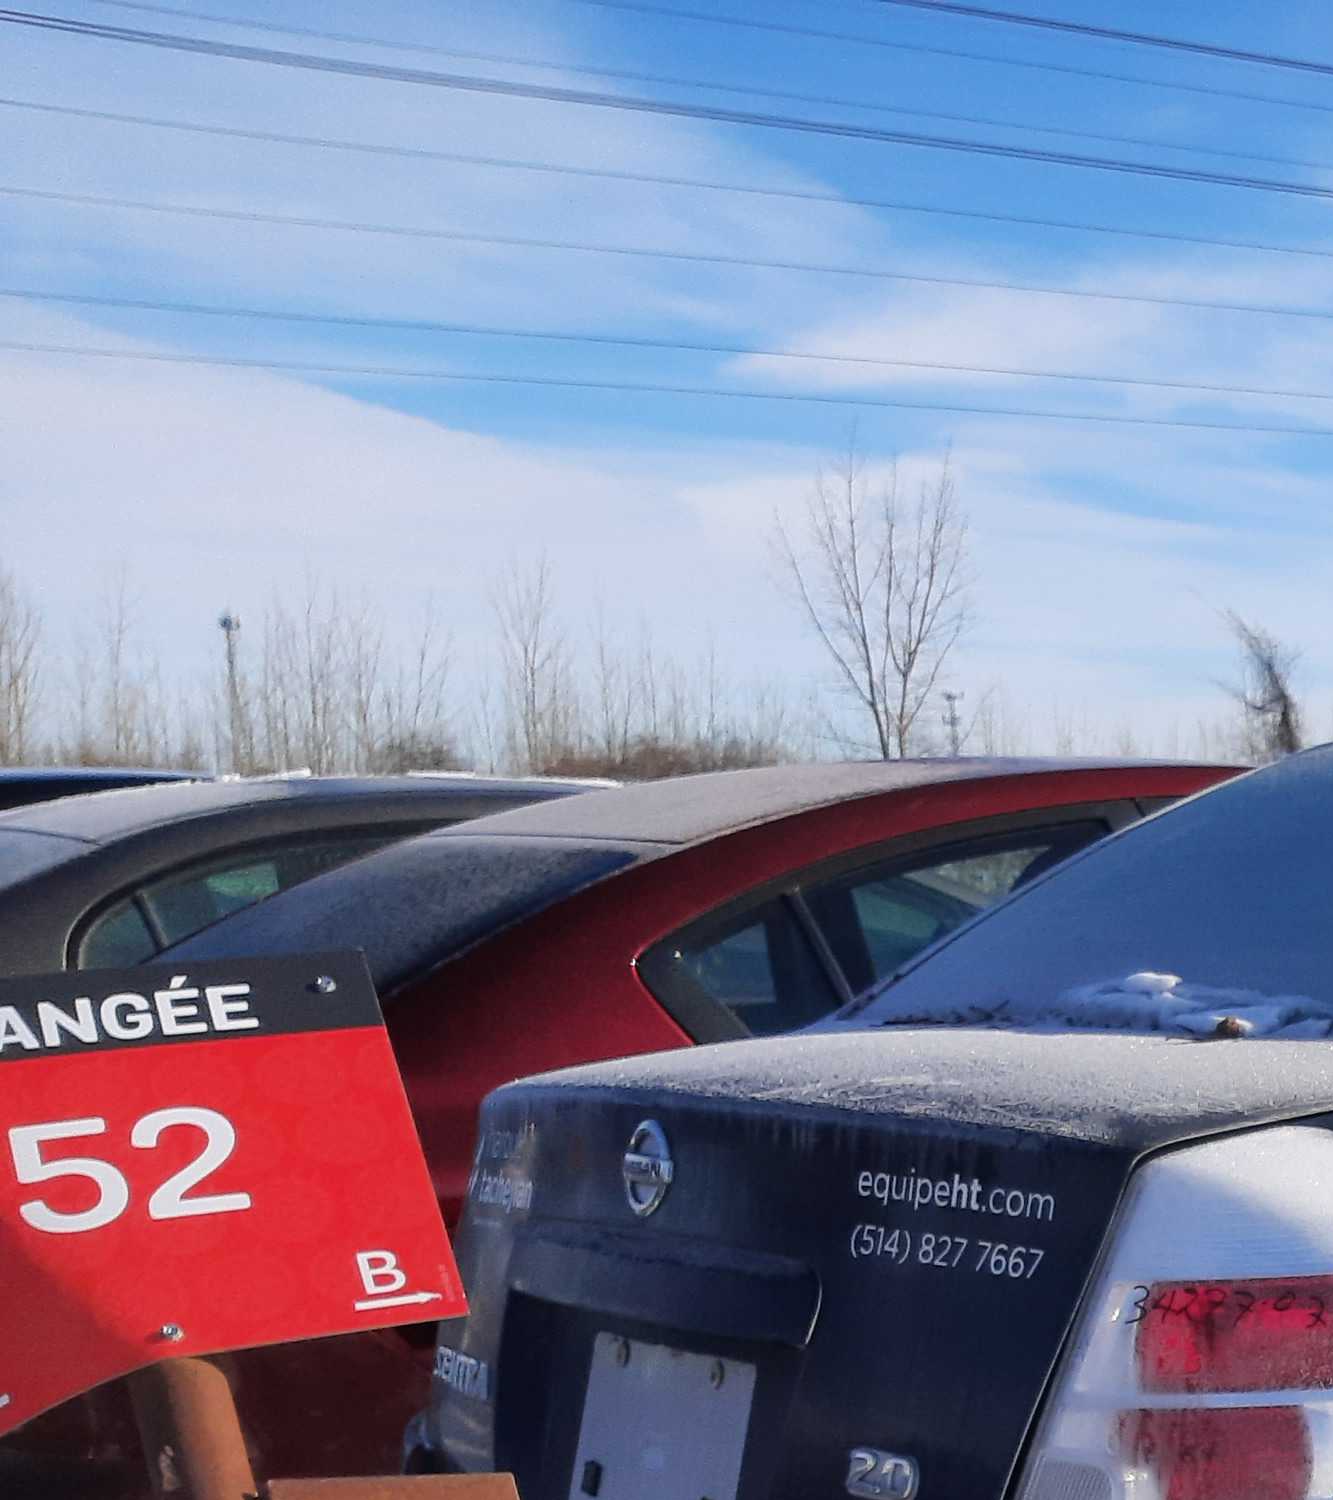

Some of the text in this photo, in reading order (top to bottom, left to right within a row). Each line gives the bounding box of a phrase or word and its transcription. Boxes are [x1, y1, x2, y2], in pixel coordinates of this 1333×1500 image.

[0, 975, 259, 1050] ANGÉE
[9, 1106, 251, 1233] 52
[858, 1167, 1056, 1222] equipeht.com
[356, 1250, 406, 1295] B
[850, 1224, 1044, 1279] (514) 827 7667
